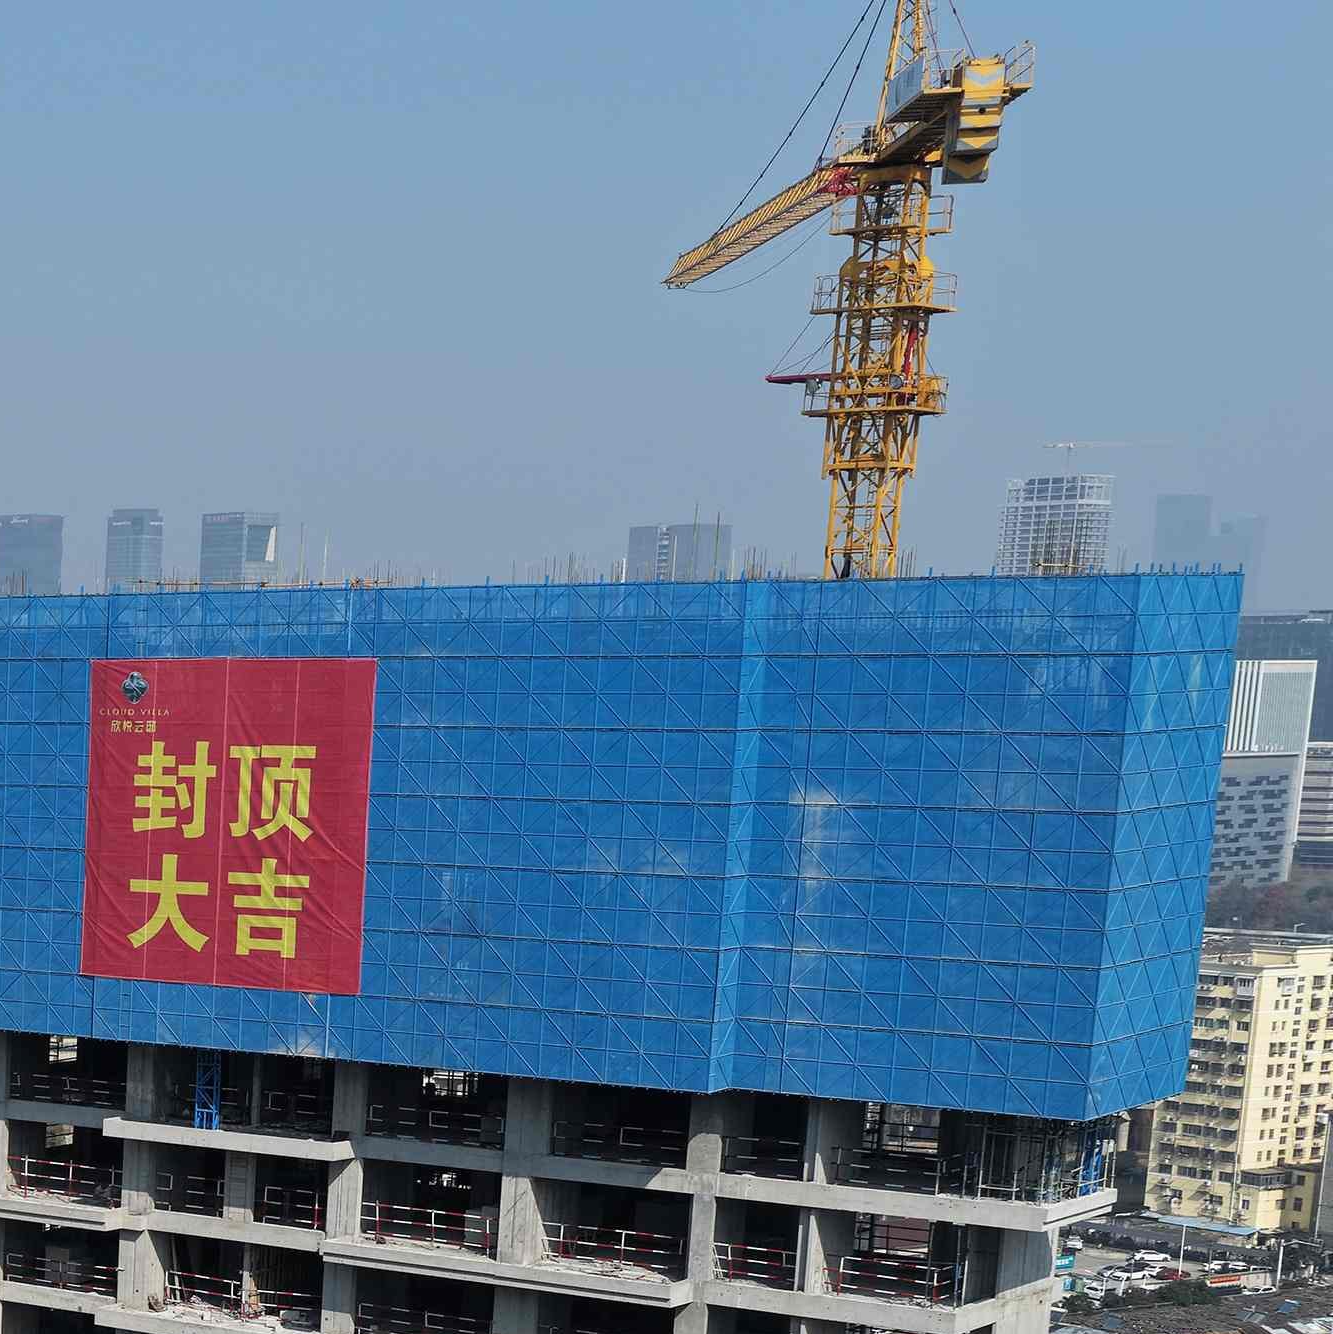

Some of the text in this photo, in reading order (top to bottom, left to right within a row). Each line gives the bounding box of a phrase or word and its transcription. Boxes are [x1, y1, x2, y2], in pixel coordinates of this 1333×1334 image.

[99, 707, 170, 716] CLOUD VILLA
[132, 740, 318, 843] 封顶
[125, 853, 311, 959] 大吉
